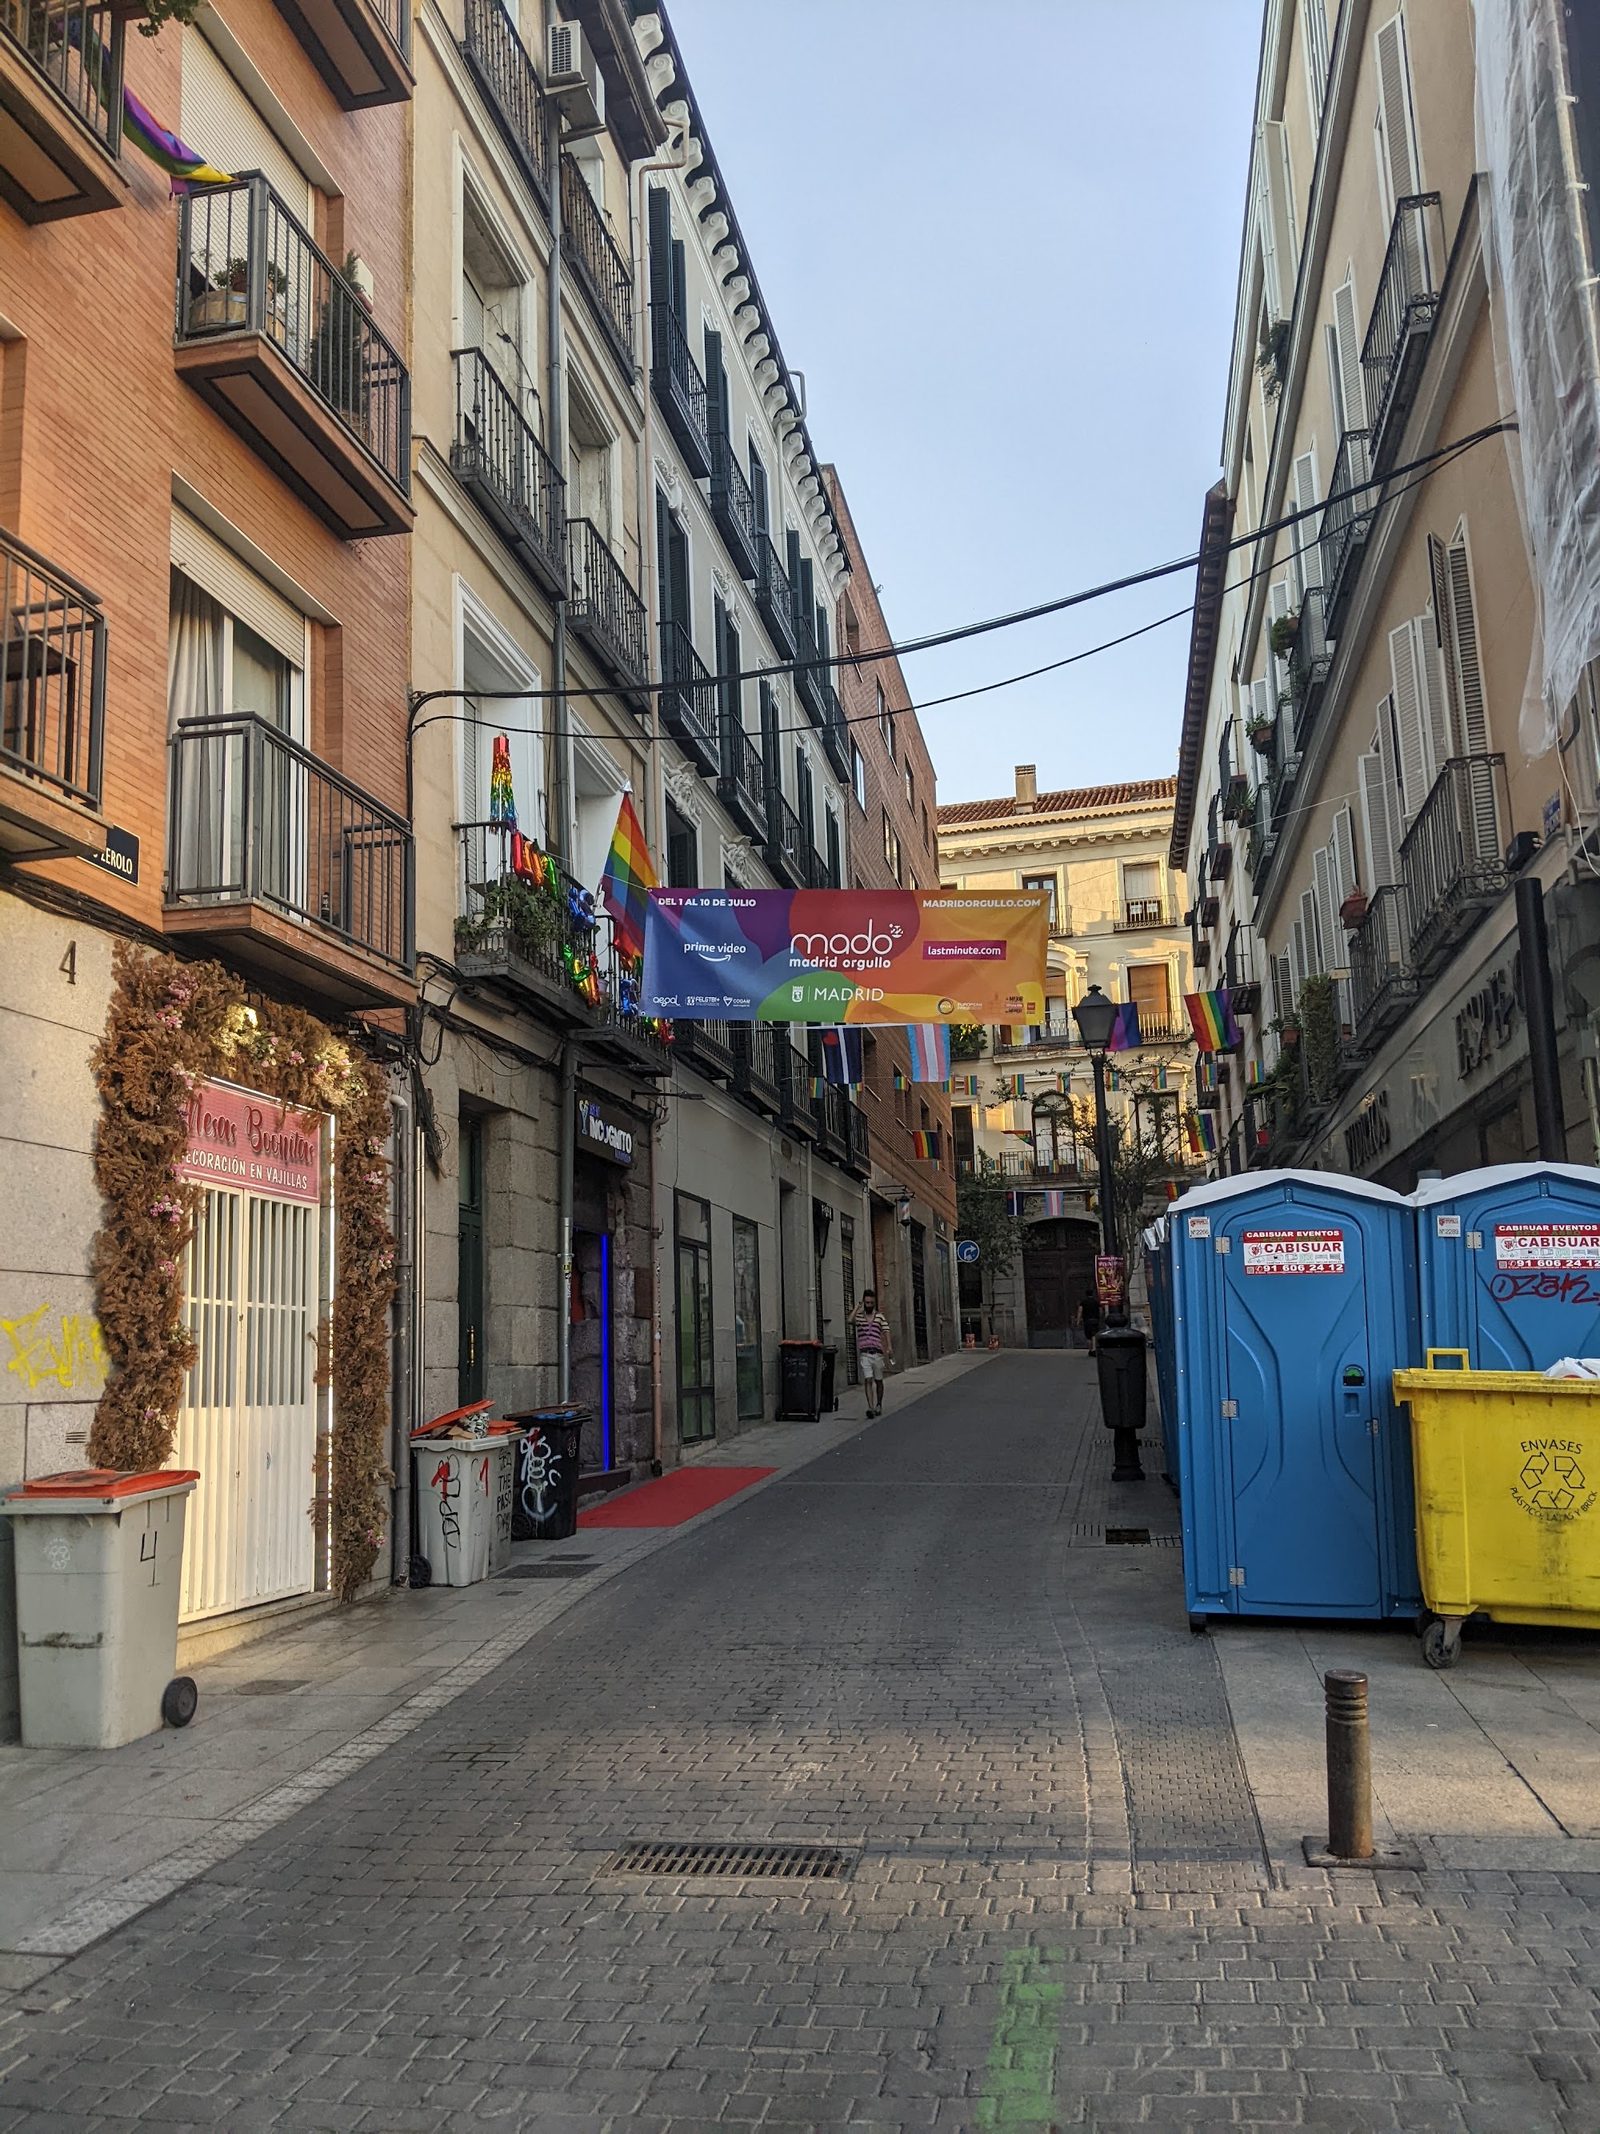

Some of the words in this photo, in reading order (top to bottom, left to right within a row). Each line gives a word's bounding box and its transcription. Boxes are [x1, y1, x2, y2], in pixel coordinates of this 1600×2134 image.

[658, 898, 677, 906] DEL
[685, 898, 698, 906] AL
[700, 898, 710, 906] 10
[713, 898, 726, 907] DE
[728, 898, 757, 907] JULIO
[922, 898, 1041, 908] MADRIDORGULLO.COM
[790, 918, 893, 955] mado
[683, 941, 716, 954] prime
[717, 942, 747, 954] video
[927, 945, 1001, 955] lastminute.com
[59, 940, 76, 985] 4
[789, 956, 838, 968] madrid
[842, 956, 891, 971] orgullo
[814, 987, 884, 1001] MADRID
[182, 1148, 246, 1175] ECORACIÓN
[250, 1162, 263, 1179] EN
[266, 1167, 308, 1190] VAJILLAS
[1246, 1230, 1294, 1239] CABISUAR
[1296, 1229, 1340, 1238] EVENTOS
[1264, 1242, 1342, 1253] CABISUAR
[1517, 1236, 1600, 1247] CABISUAR
[1263, 1264, 1278, 1272] 91
[1282, 1264, 1305, 1272] 606
[1329, 1263, 1344, 1271] 12
[1516, 1259, 1532, 1267] 91
[1537, 1259, 1561, 1267] 606
[1566, 1259, 1582, 1267] 24
[1520, 1439, 1583, 1455] ENVASES
[1580, 1490, 1598, 1512] BRICK
